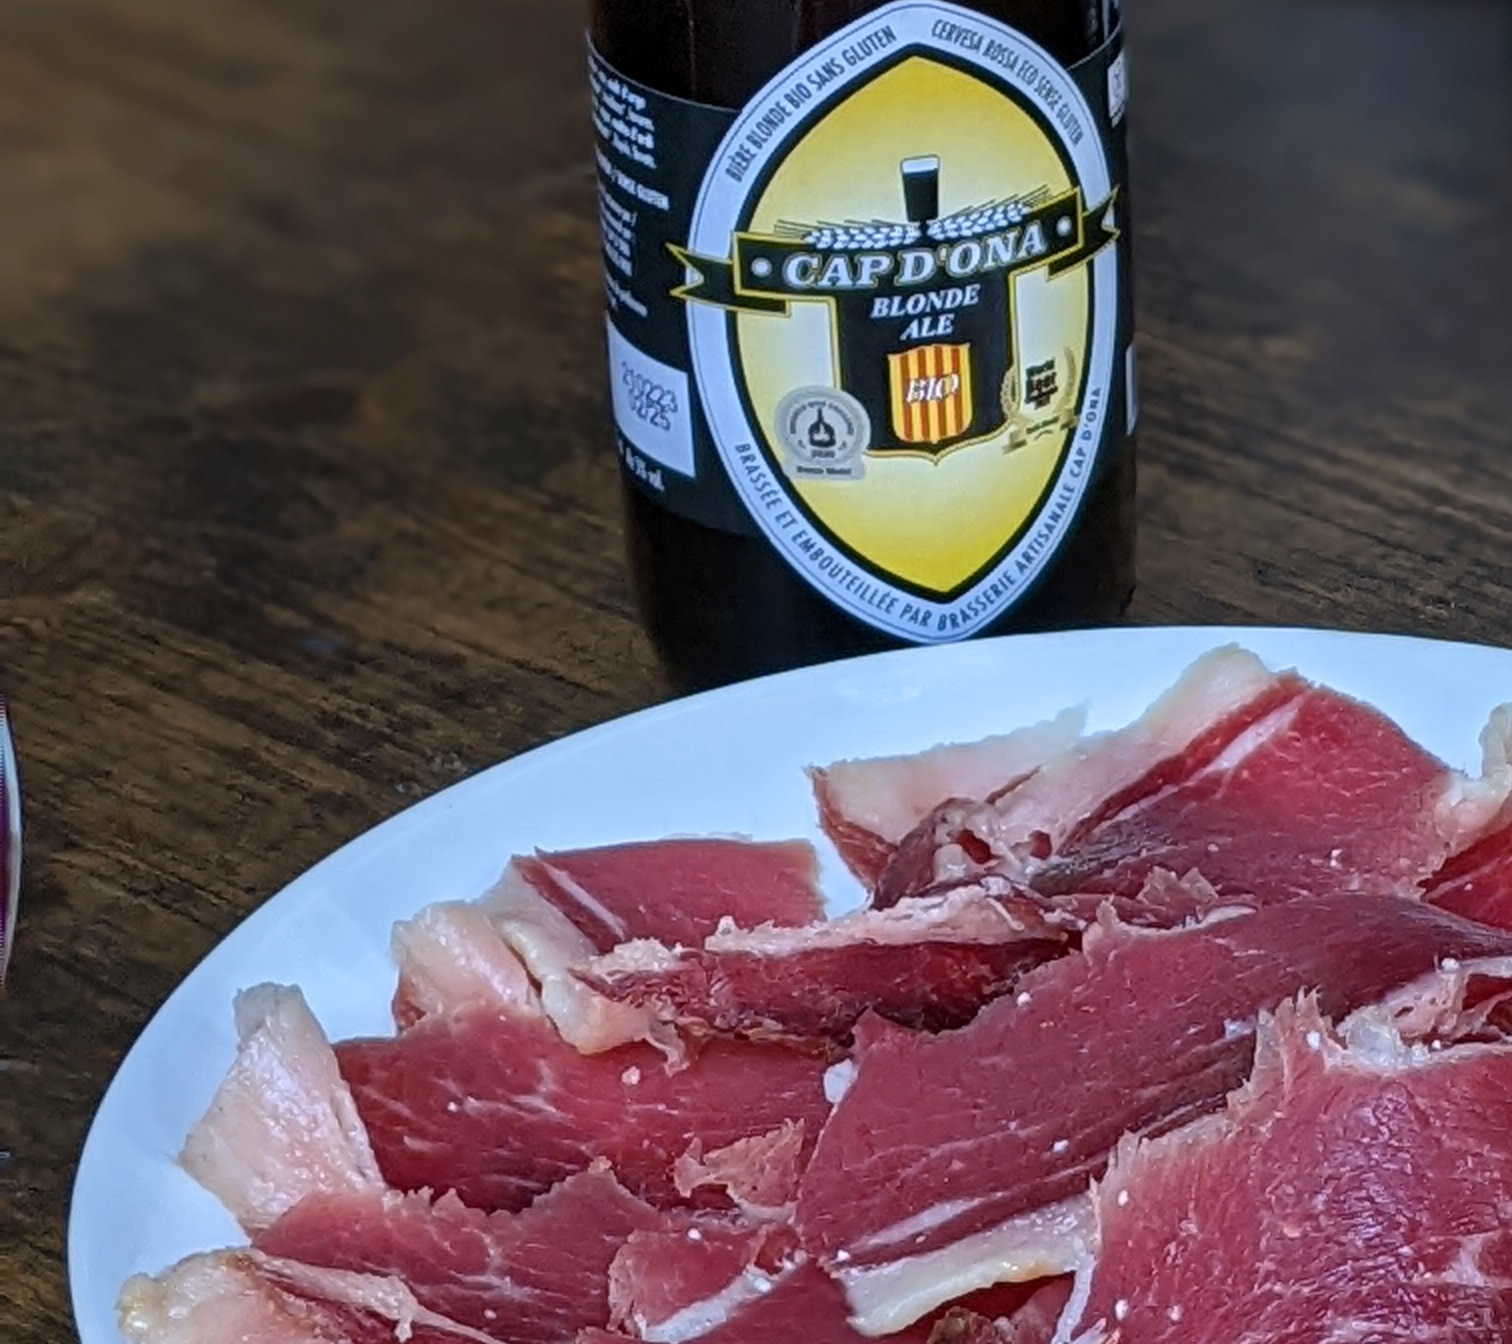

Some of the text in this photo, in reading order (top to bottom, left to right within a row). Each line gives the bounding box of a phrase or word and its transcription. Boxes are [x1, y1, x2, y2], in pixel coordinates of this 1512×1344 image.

[931, 19, 984, 54] CERVESA
[983, 39, 1019, 73] ROSSA
[1015, 60, 1039, 86] ECO
[725, 25, 897, 183] BIÈRE BLONDE BIO SANS GLUTEN
[783, 220, 1047, 289] CAP D'ONA
[870, 283, 981, 319] BLONDE
[900, 313, 955, 341] ALE
[906, 373, 959, 404] BIO
[735, 443, 782, 511] BRASSÉE
[775, 510, 799, 530] ET
[791, 529, 898, 614] EMBOUTEILLÉE
[899, 603, 932, 628] PAR
[936, 572, 1016, 632] BRASSERIE
[1017, 484, 1075, 575] ARTISANALE
[1069, 447, 1086, 479] CAP
